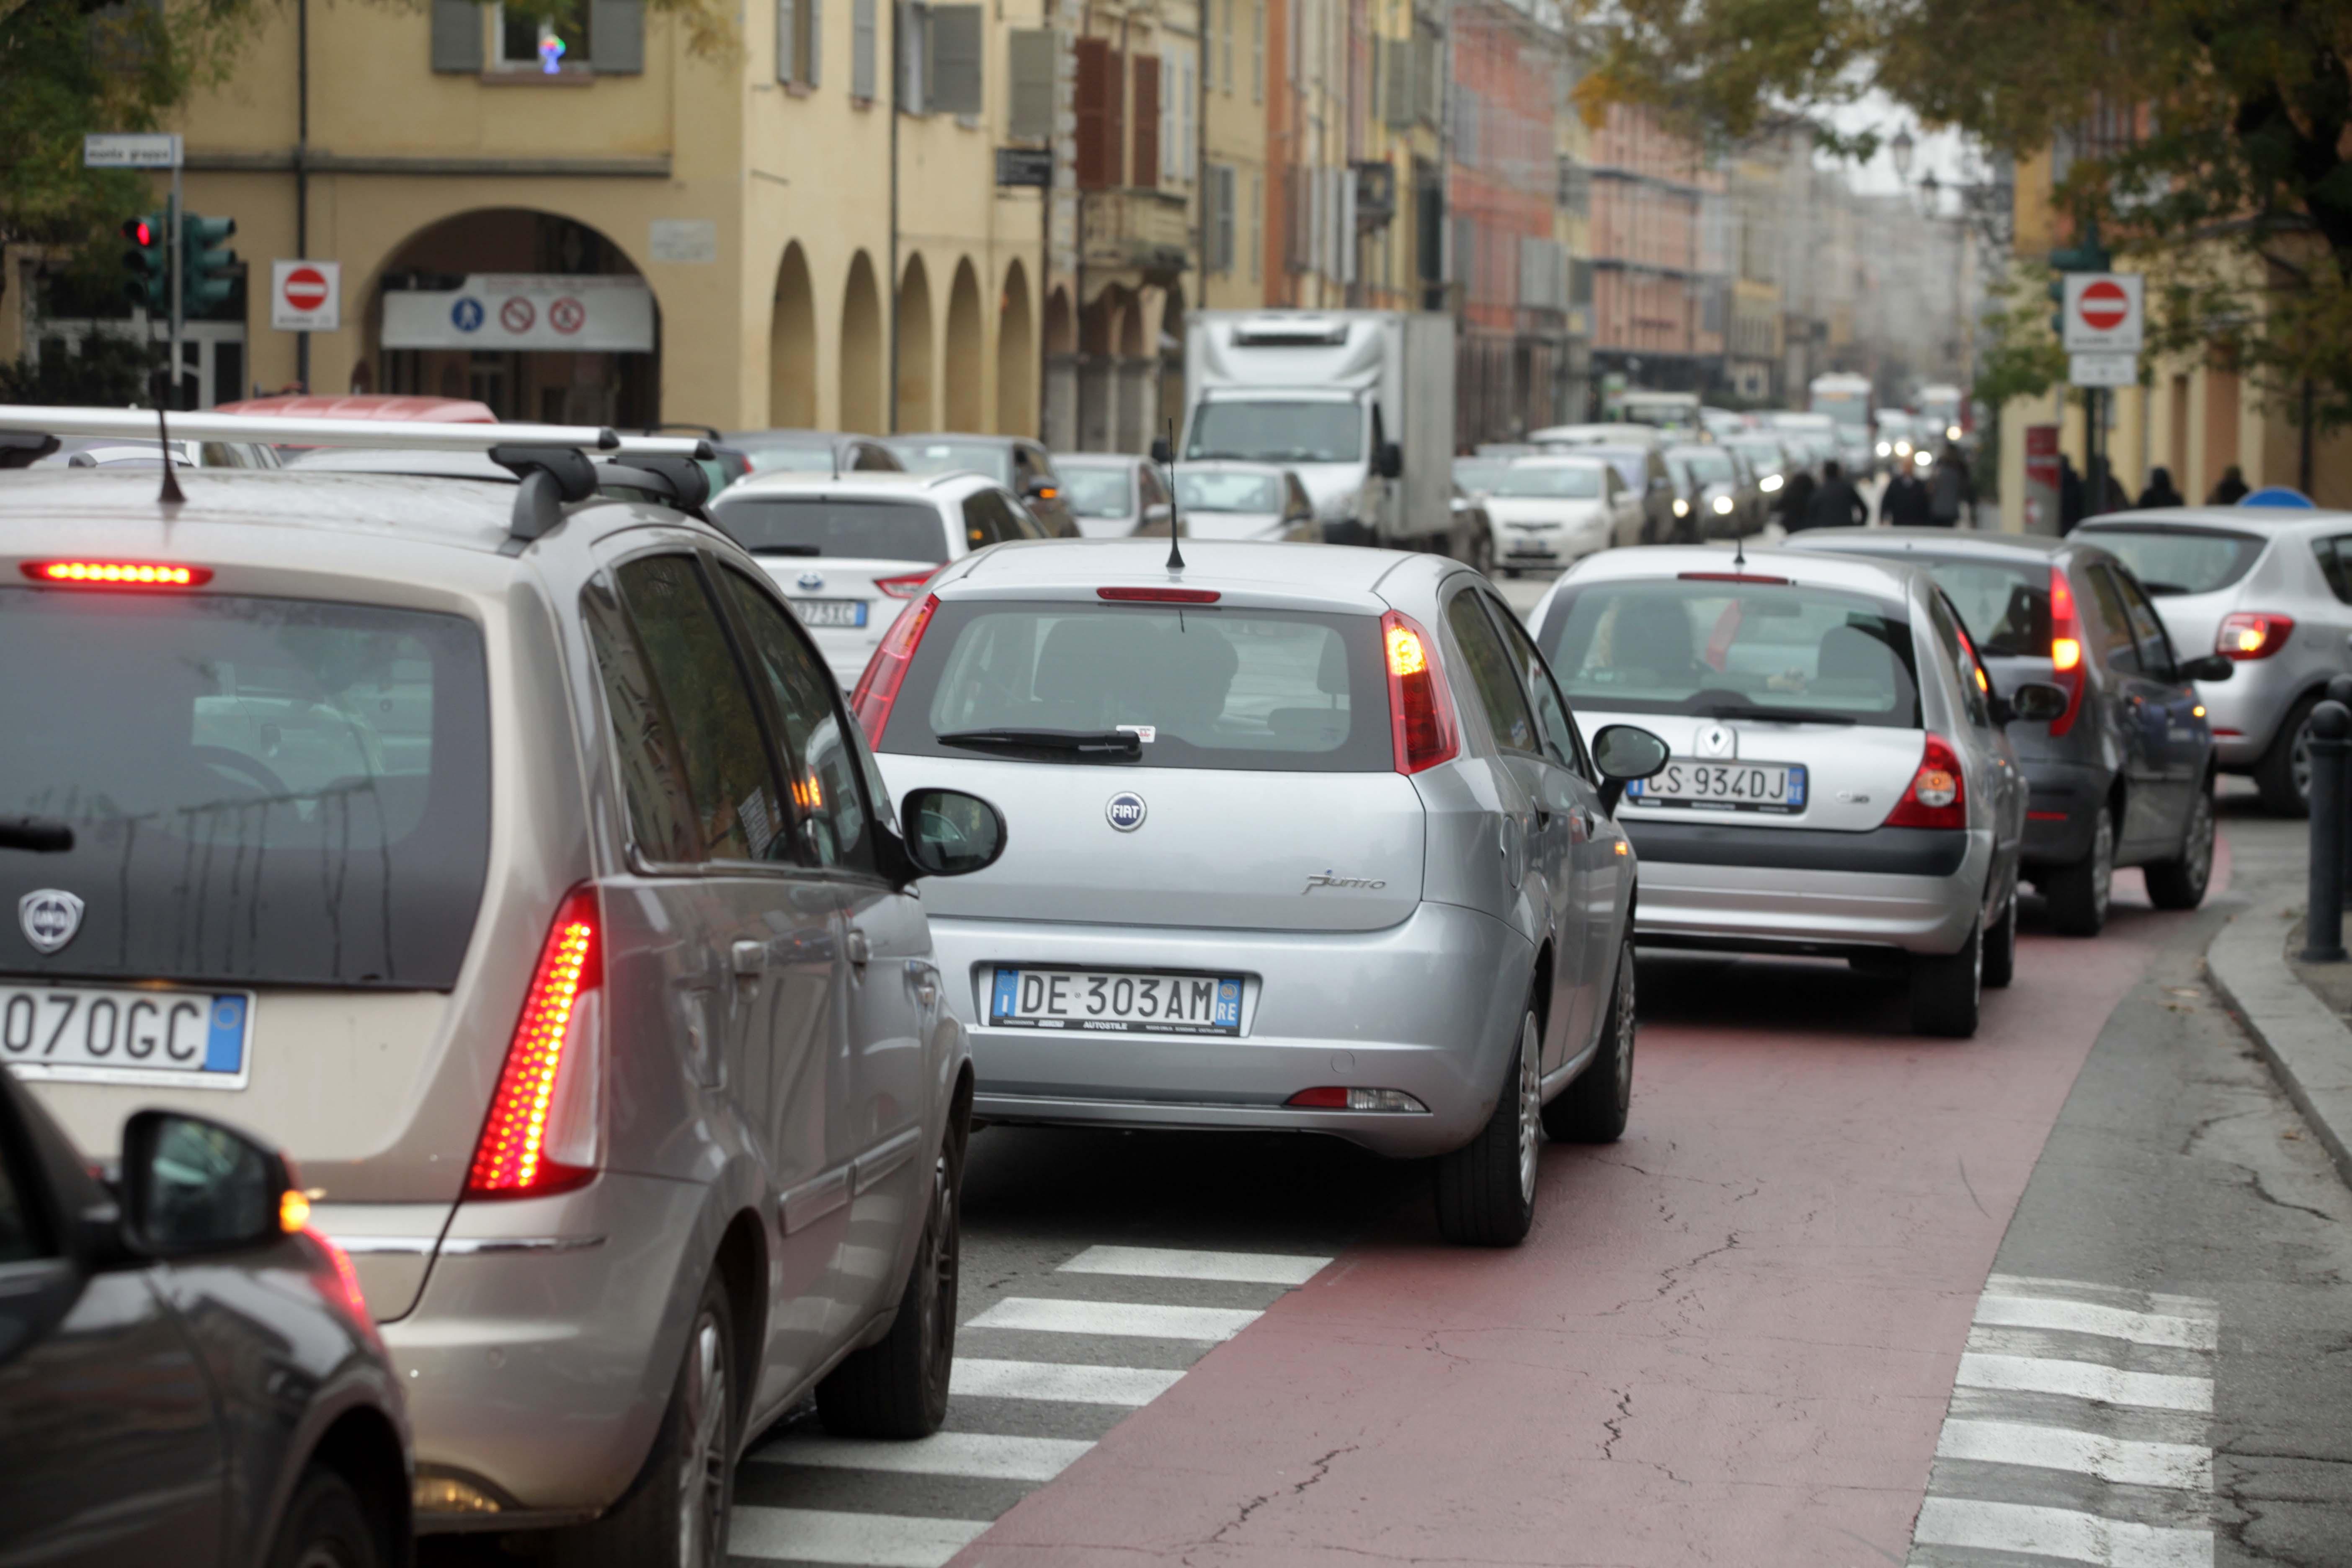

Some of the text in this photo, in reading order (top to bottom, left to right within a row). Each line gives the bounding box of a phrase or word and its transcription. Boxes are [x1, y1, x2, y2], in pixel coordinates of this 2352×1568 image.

[1694, 767, 1785, 799] 934DJ
[1112, 804, 1140, 819] FIAT
[1022, 975, 1070, 1014] DE
[1086, 976, 1213, 1021] 303AM
[1217, 1002, 1237, 1021] RE
[3, 993, 200, 1061] 070GC
[1083, 1021, 1128, 1030] AUTOSTILE
